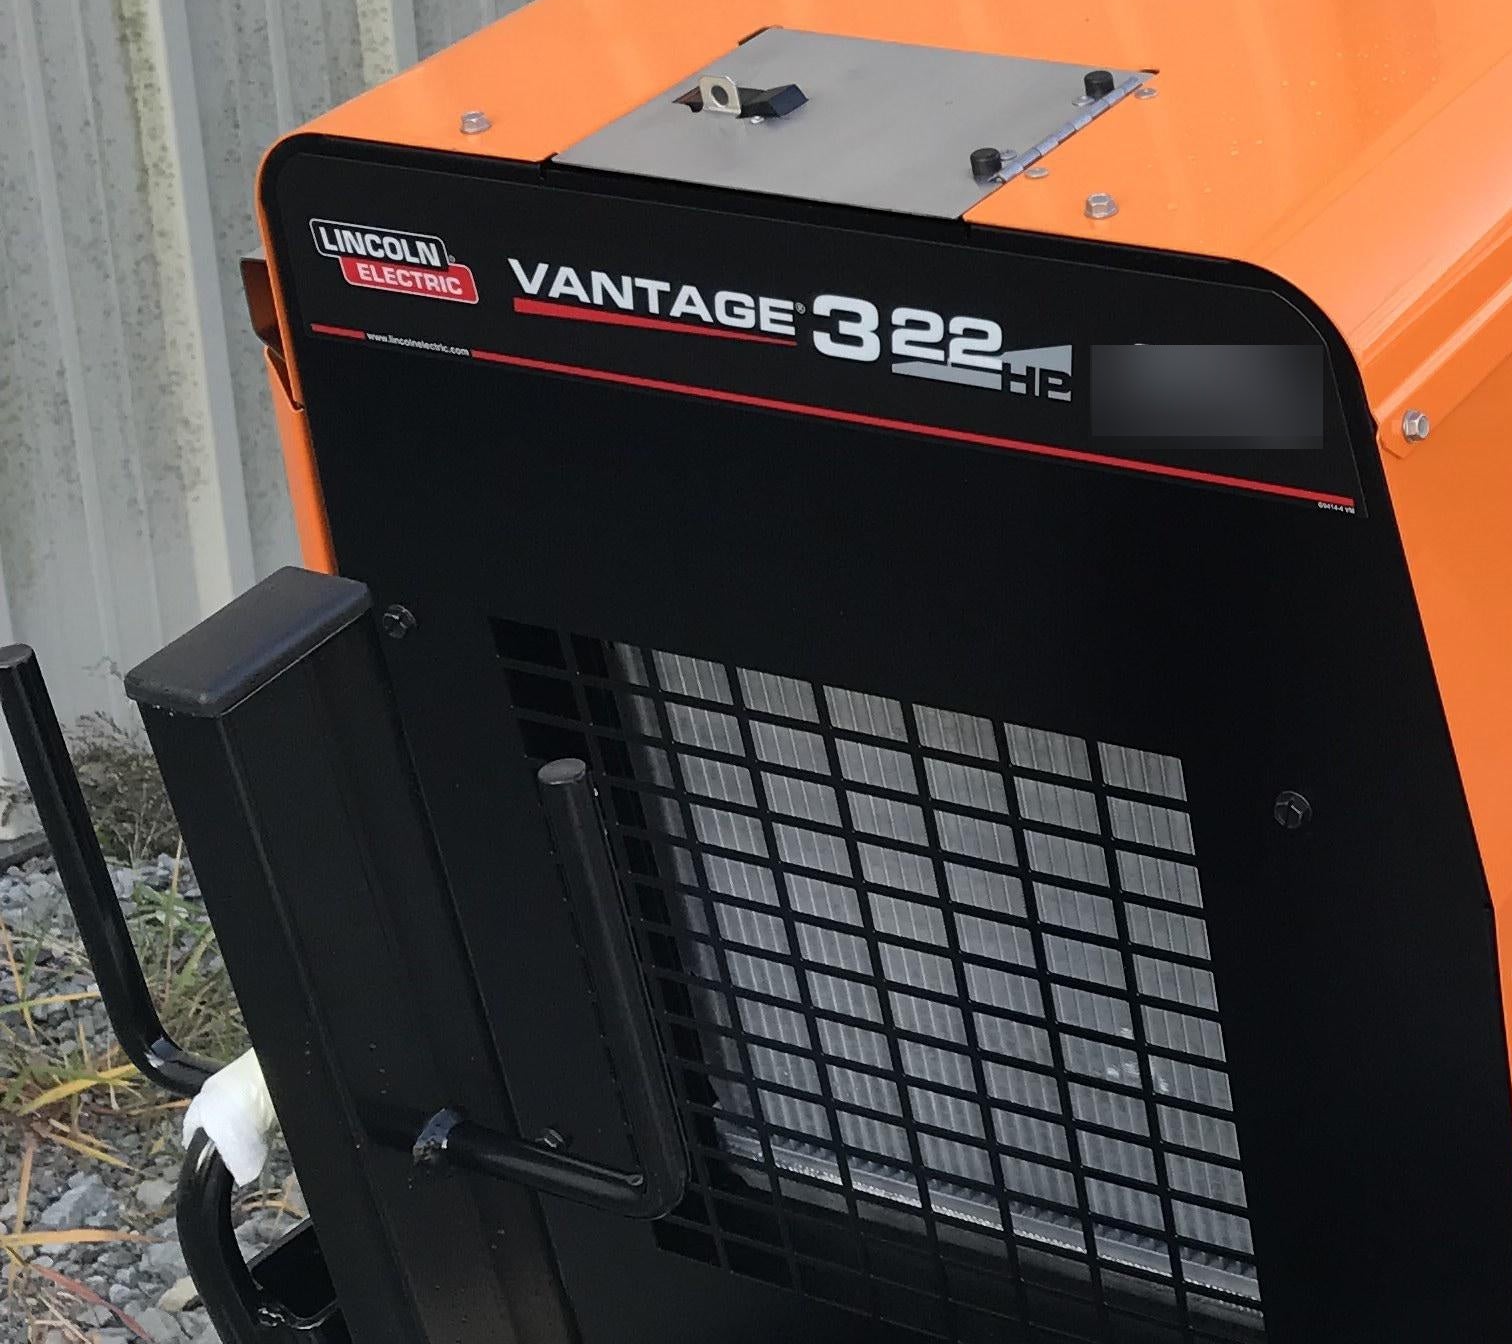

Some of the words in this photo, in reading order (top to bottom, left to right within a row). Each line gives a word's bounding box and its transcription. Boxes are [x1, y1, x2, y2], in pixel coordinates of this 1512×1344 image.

[318, 226, 442, 268] LINCOLN
[356, 262, 463, 296] ELECTRIC
[366, 332, 470, 356] www.lincolnelectric.com
[812, 294, 1003, 371] 322
